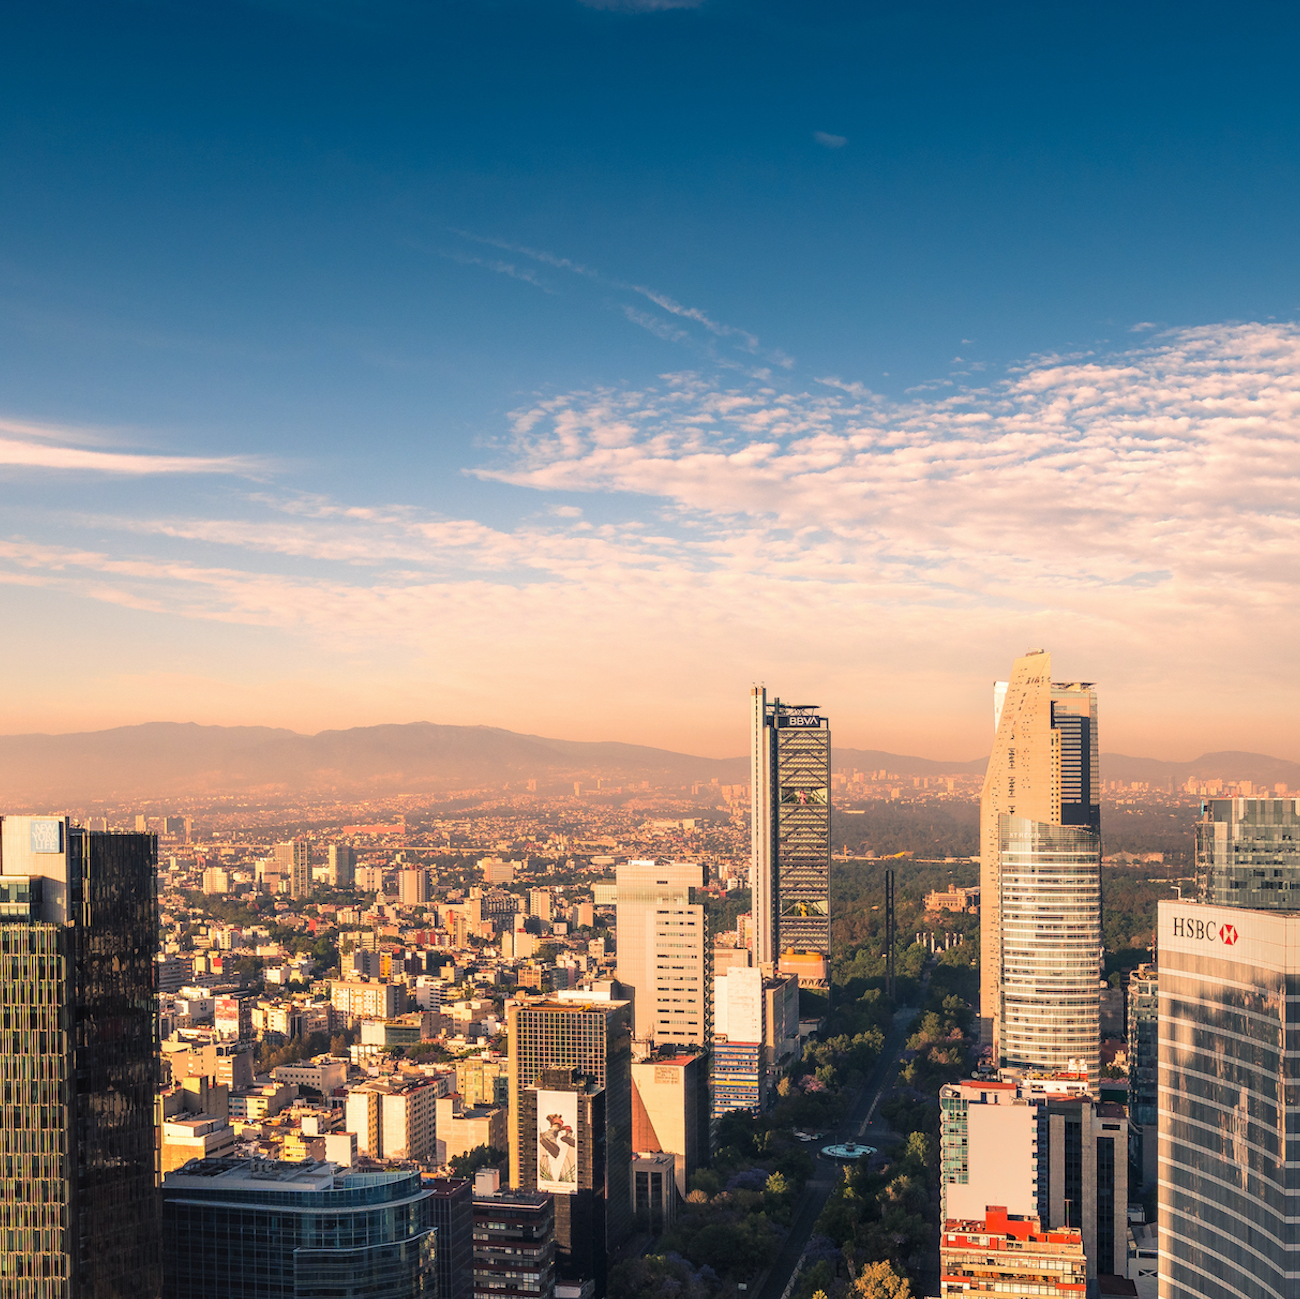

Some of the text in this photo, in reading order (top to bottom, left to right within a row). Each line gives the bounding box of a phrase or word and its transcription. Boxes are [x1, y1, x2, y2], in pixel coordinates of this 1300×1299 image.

[789, 716, 818, 726] BBVA
[34, 823, 56, 832] NEW
[32, 831, 58, 841] YORK
[35, 840, 56, 850] LIFE
[1173, 917, 1216, 941] HSBC
